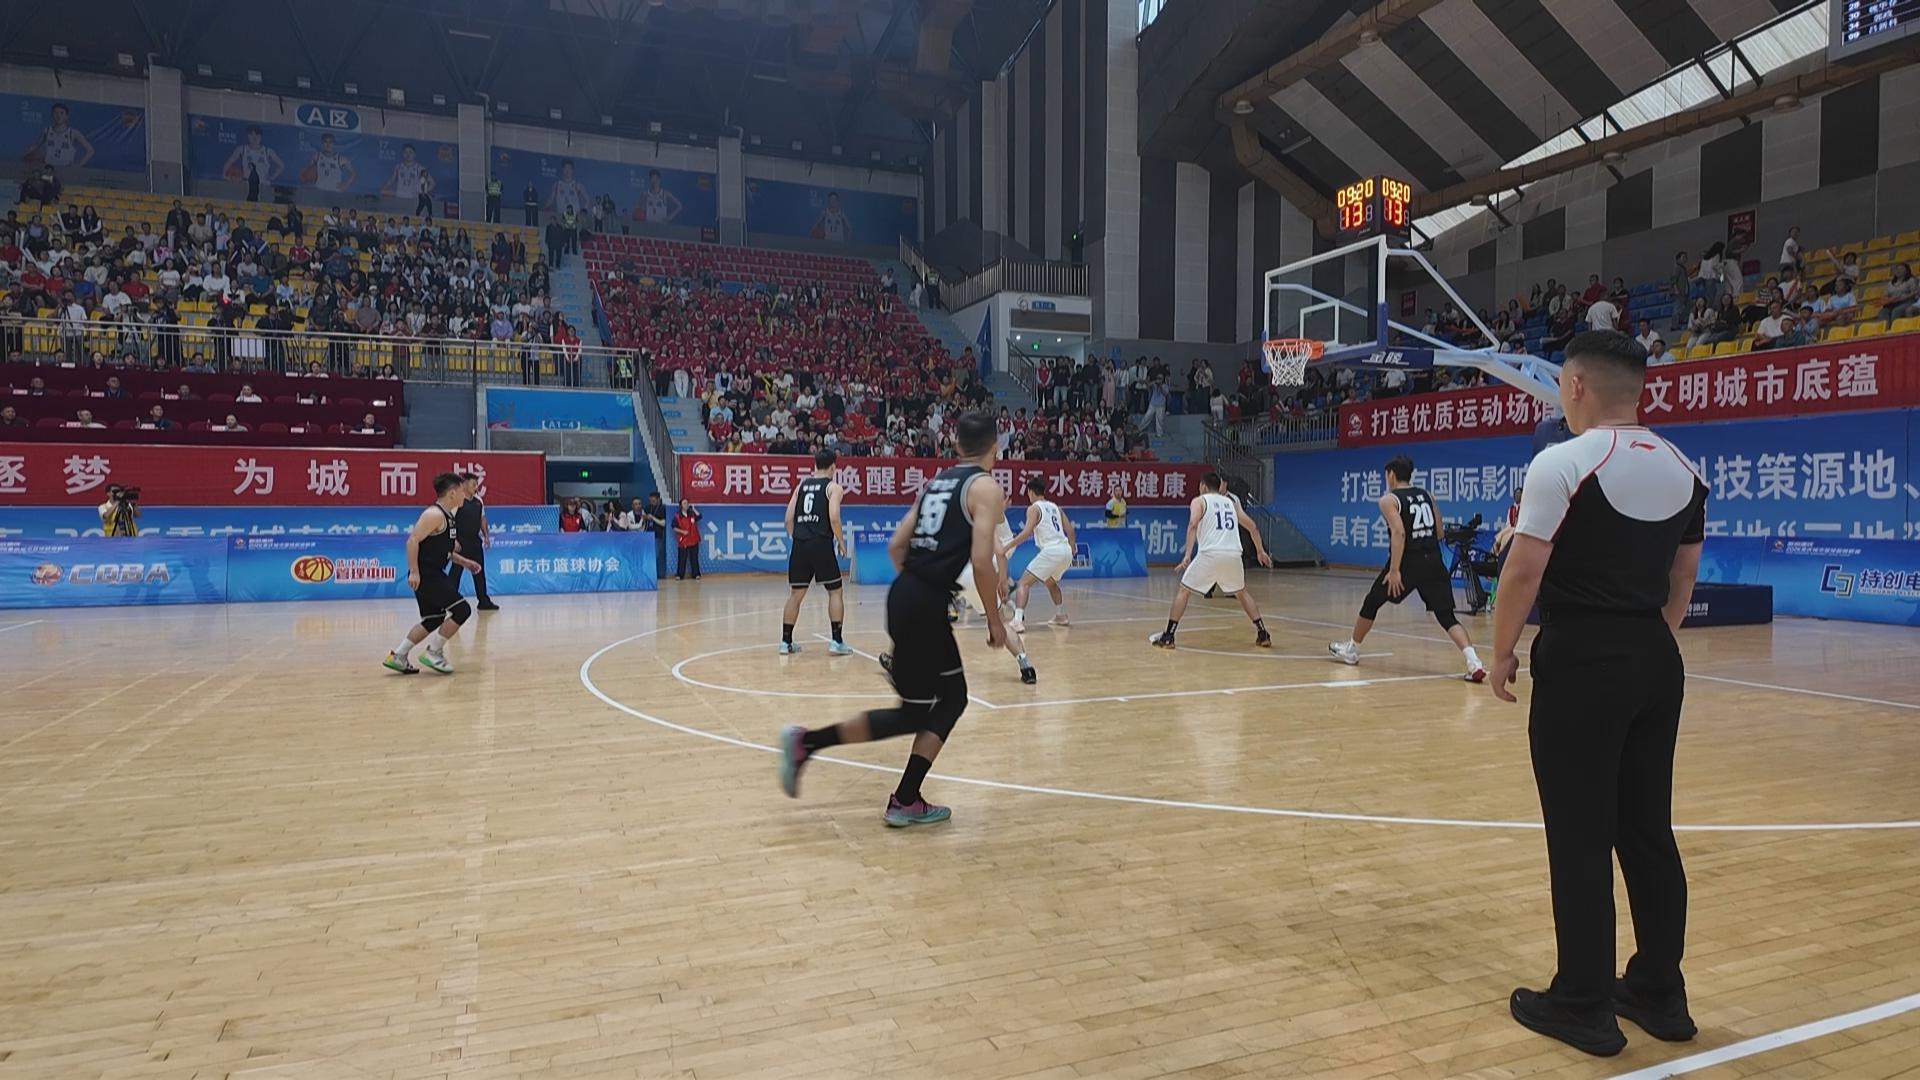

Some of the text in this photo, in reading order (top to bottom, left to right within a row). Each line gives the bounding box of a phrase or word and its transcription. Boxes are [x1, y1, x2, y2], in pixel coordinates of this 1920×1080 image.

[307, 106, 348, 128] A区
[1644, 353, 1879, 413] 文明城市底蕴
[803, 492, 815, 515] 6
[1051, 514, 1061, 532] 6
[1214, 511, 1235, 531] 15
[1410, 502, 1434, 530] 20
[69, 562, 170, 585] CQBA
[499, 556, 621, 575] 重庆市篮球协会
